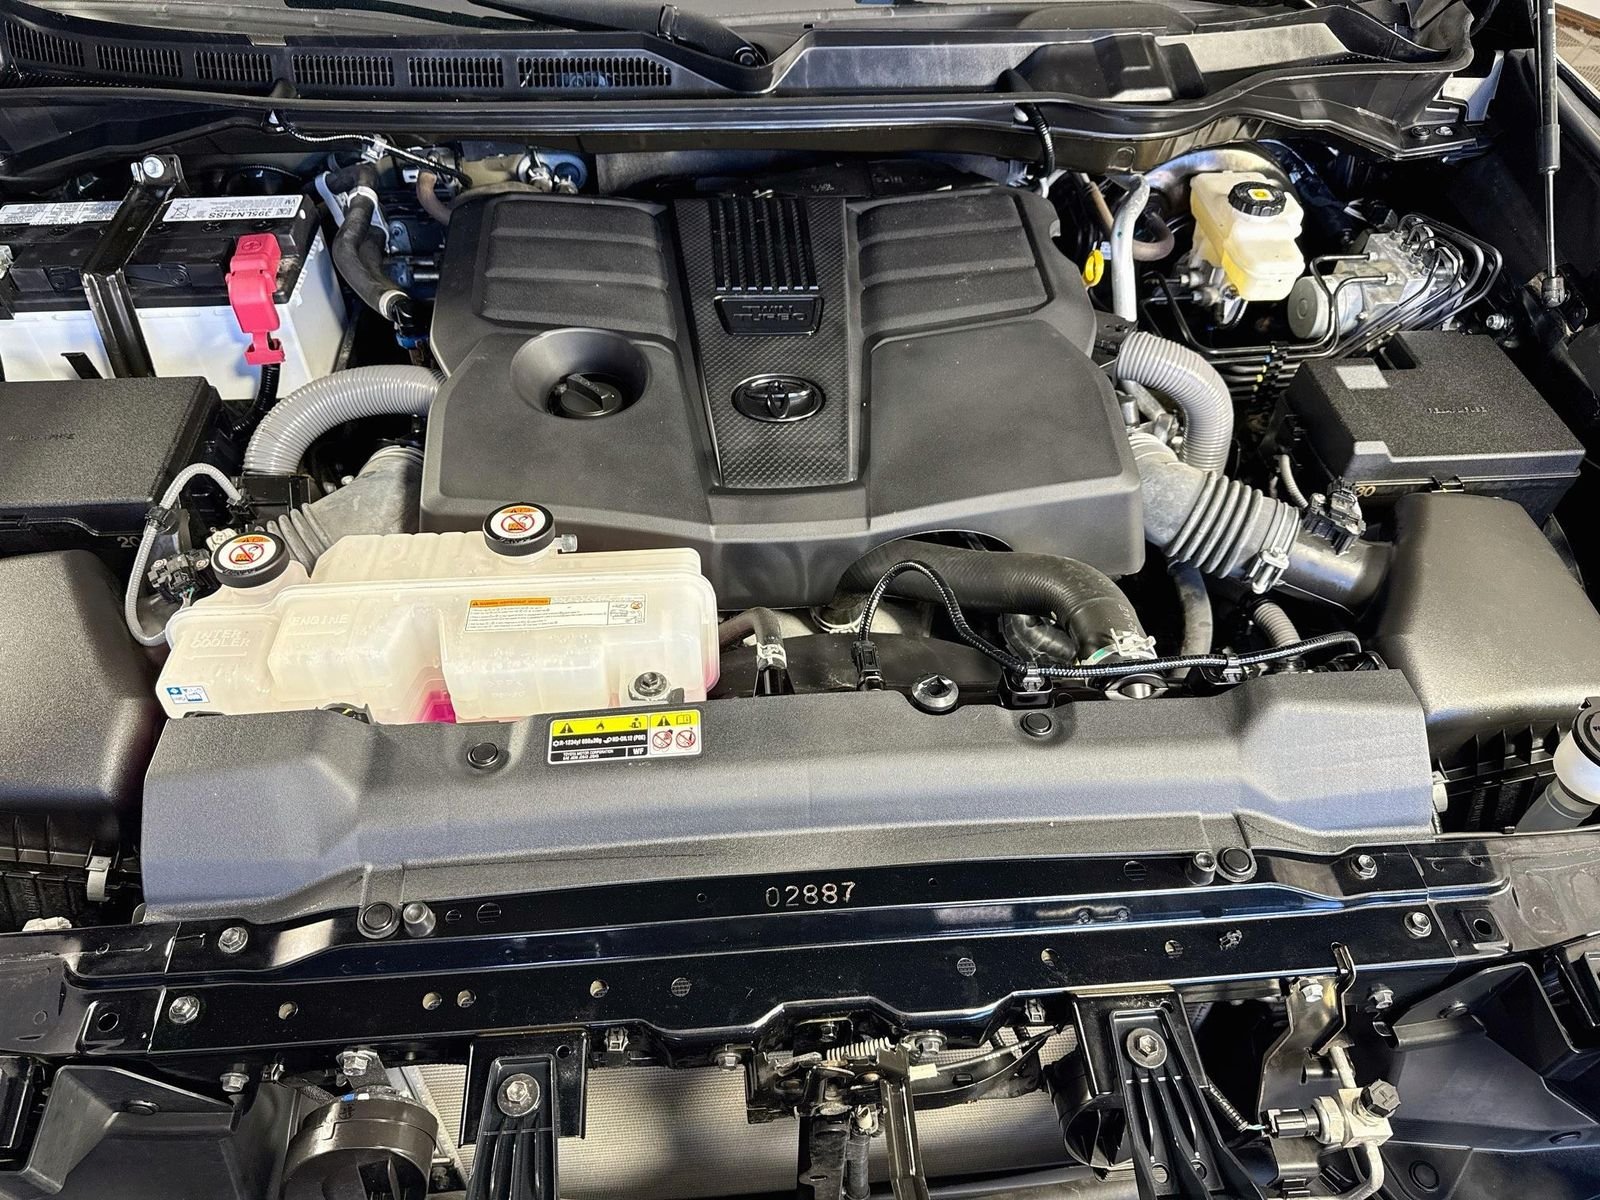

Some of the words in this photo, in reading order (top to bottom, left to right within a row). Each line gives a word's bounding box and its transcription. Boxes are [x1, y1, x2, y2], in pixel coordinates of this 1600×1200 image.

[742, 305, 794, 313] TWIN
[733, 313, 806, 321] TURBO
[291, 614, 350, 625] ENGINE
[194, 629, 243, 639] INTER
[190, 637, 251, 648] COOLER
[633, 747, 644, 755] WF
[765, 881, 856, 907] 02887
